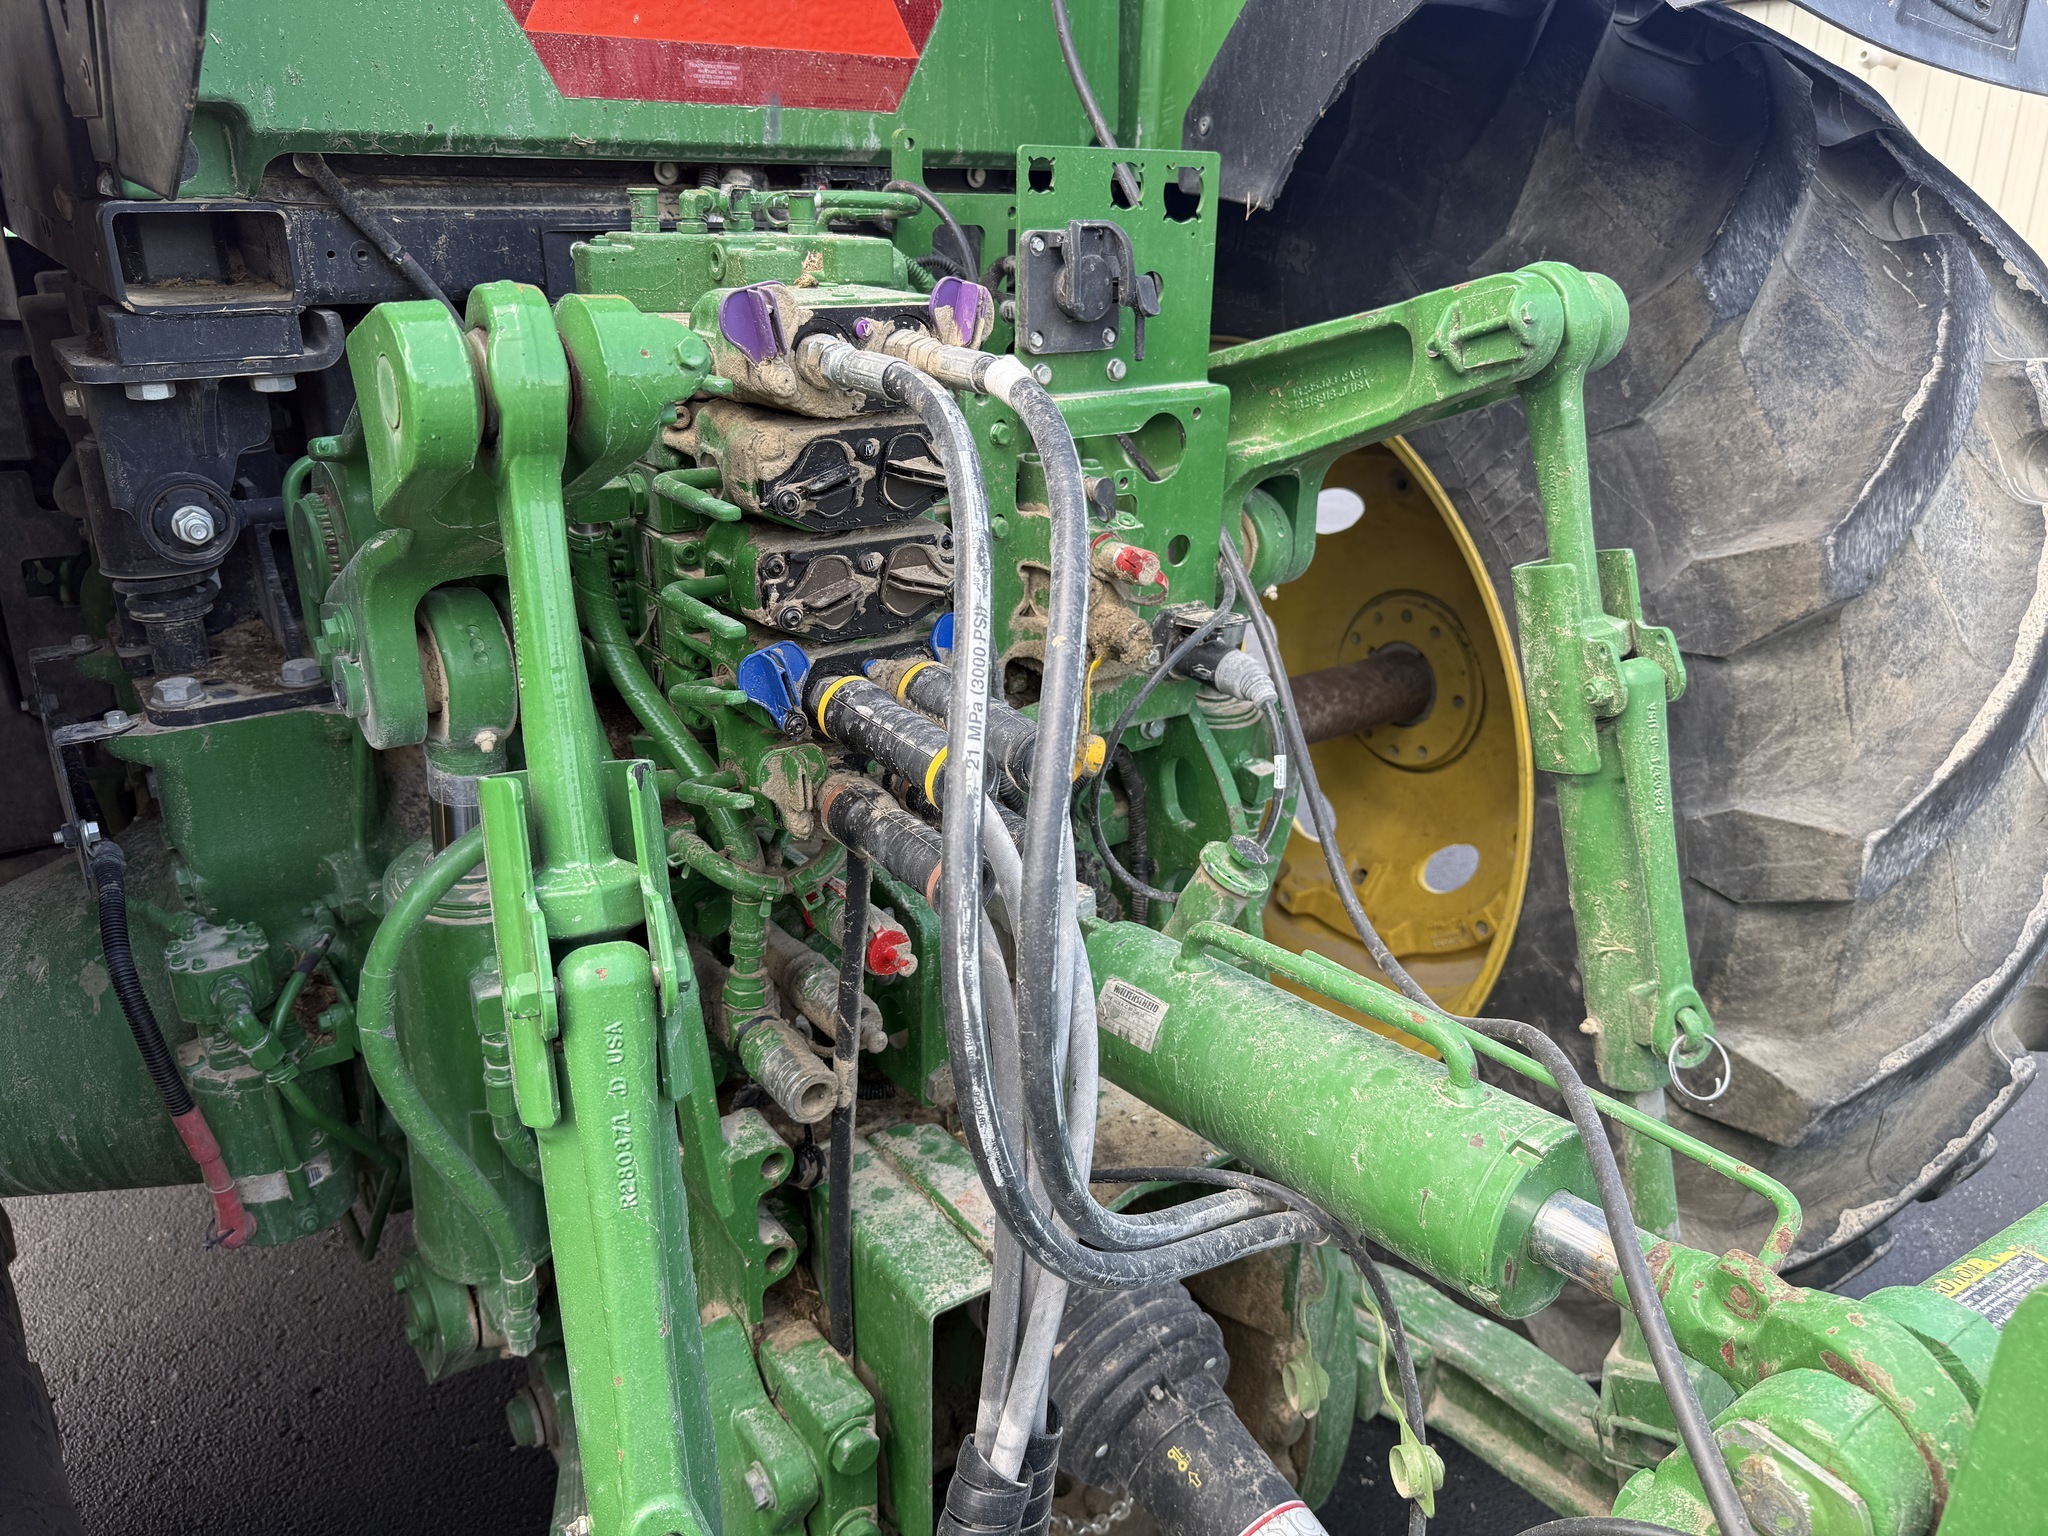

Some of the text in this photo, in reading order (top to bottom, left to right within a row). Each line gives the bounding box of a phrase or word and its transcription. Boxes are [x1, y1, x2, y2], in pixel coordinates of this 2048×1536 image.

[969, 646, 987, 695] (3000
[967, 701, 984, 741] MPa
[966, 748, 981, 771] 21
[1112, 984, 1161, 1014] WALTERSCHEID
[603, 1020, 625, 1066] USA
[610, 1110, 638, 1211] R280371
